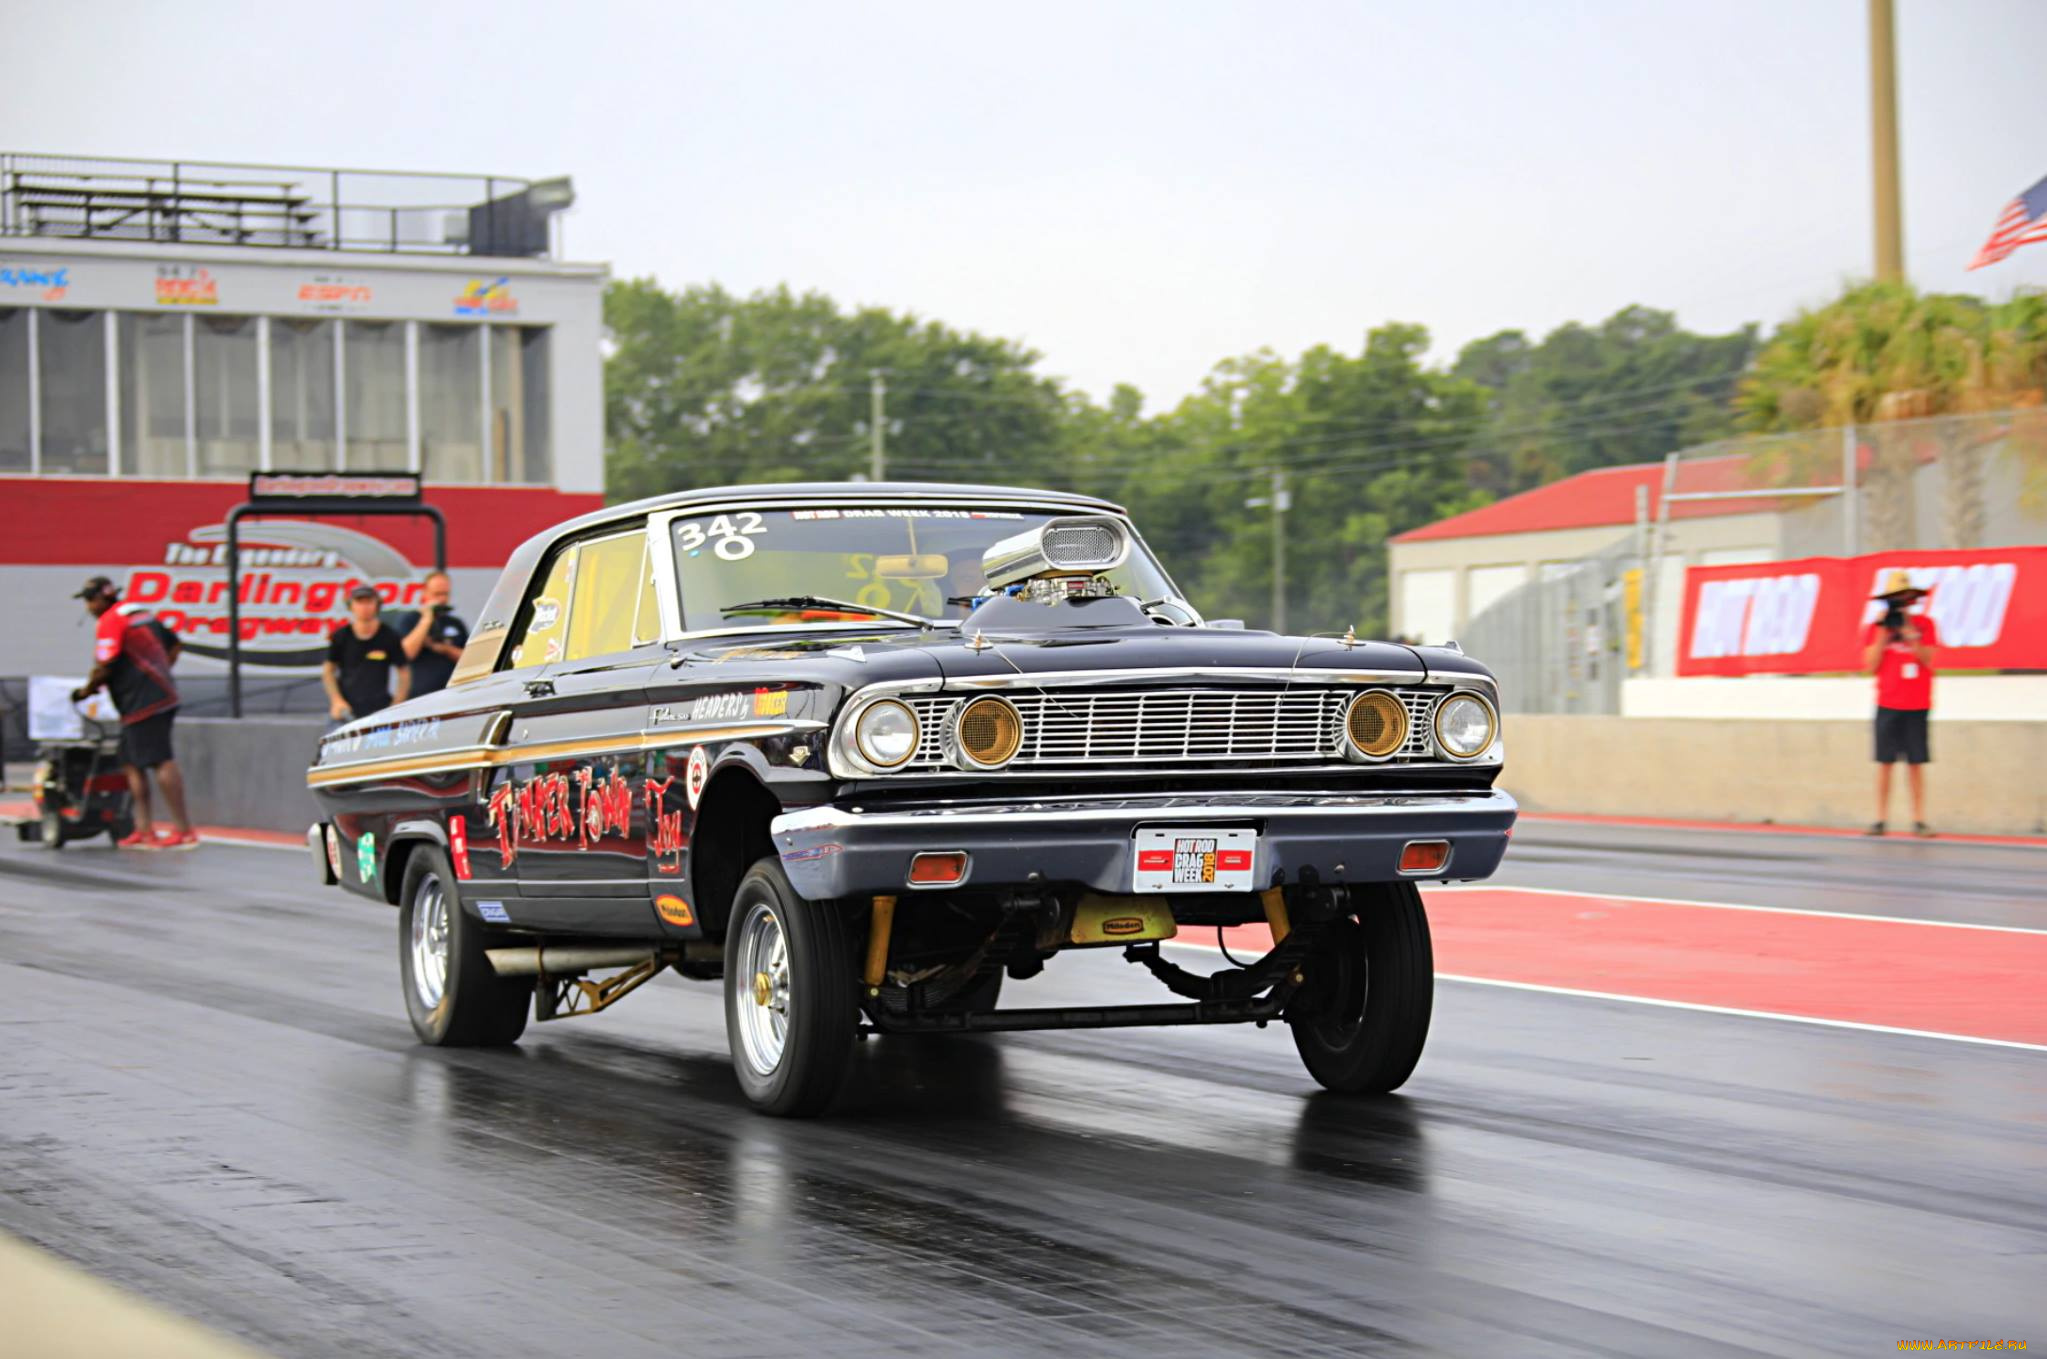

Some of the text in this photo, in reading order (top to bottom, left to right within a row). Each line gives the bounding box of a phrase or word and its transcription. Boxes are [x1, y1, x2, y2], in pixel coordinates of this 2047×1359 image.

[842, 510, 885, 518] DRAG
[886, 510, 931, 518] WEEK
[932, 510, 970, 519] 2018
[677, 511, 768, 551] 342
[691, 692, 744, 720] HEADERS
[487, 774, 576, 870] TINKER
[573, 760, 633, 851] TOWN
[1176, 839, 1216, 854] HOT ROD
[1175, 853, 1204, 868] DRAG
[1203, 853, 1215, 883] 2018
[1174, 868, 1203, 883] WEEK
